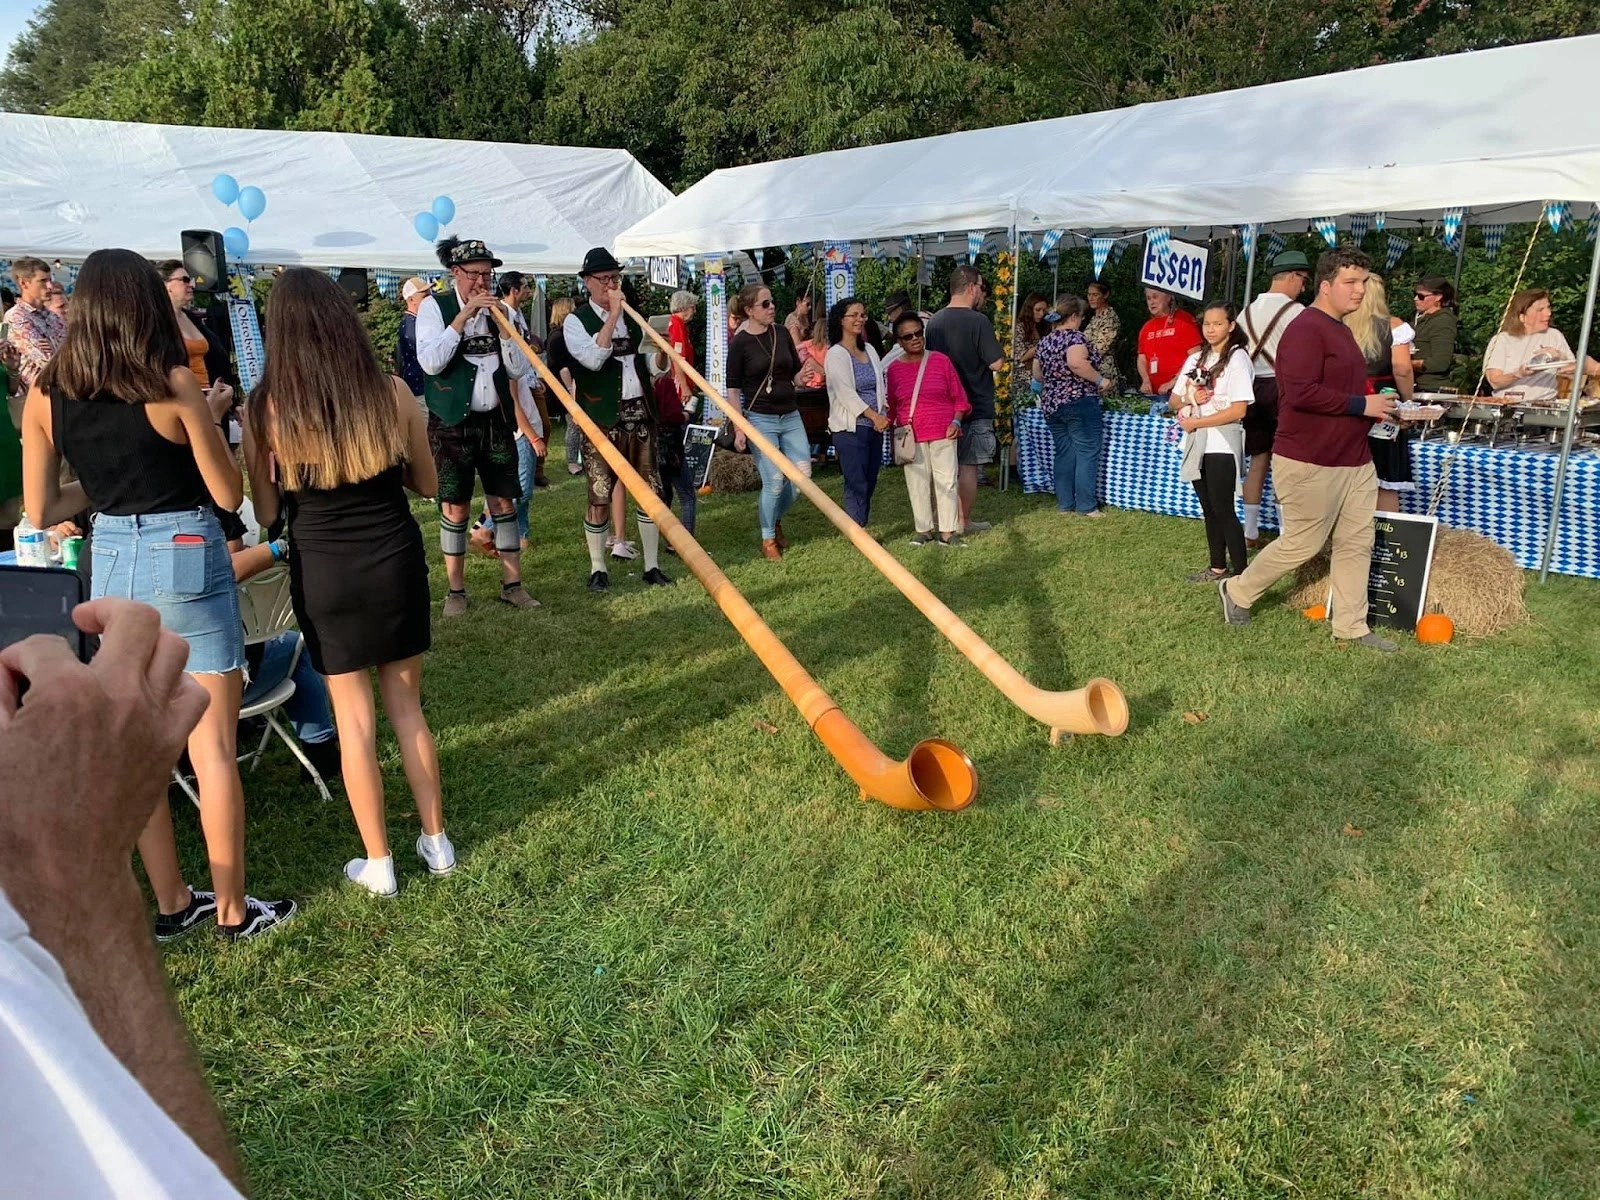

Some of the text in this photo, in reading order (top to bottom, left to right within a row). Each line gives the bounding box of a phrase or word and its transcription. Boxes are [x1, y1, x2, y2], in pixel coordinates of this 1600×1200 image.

[651, 256, 676, 286] PROST!
[1145, 240, 1202, 292] Essen
[238, 306, 258, 378] Oktoberfest
[710, 293, 721, 391] Welcom
